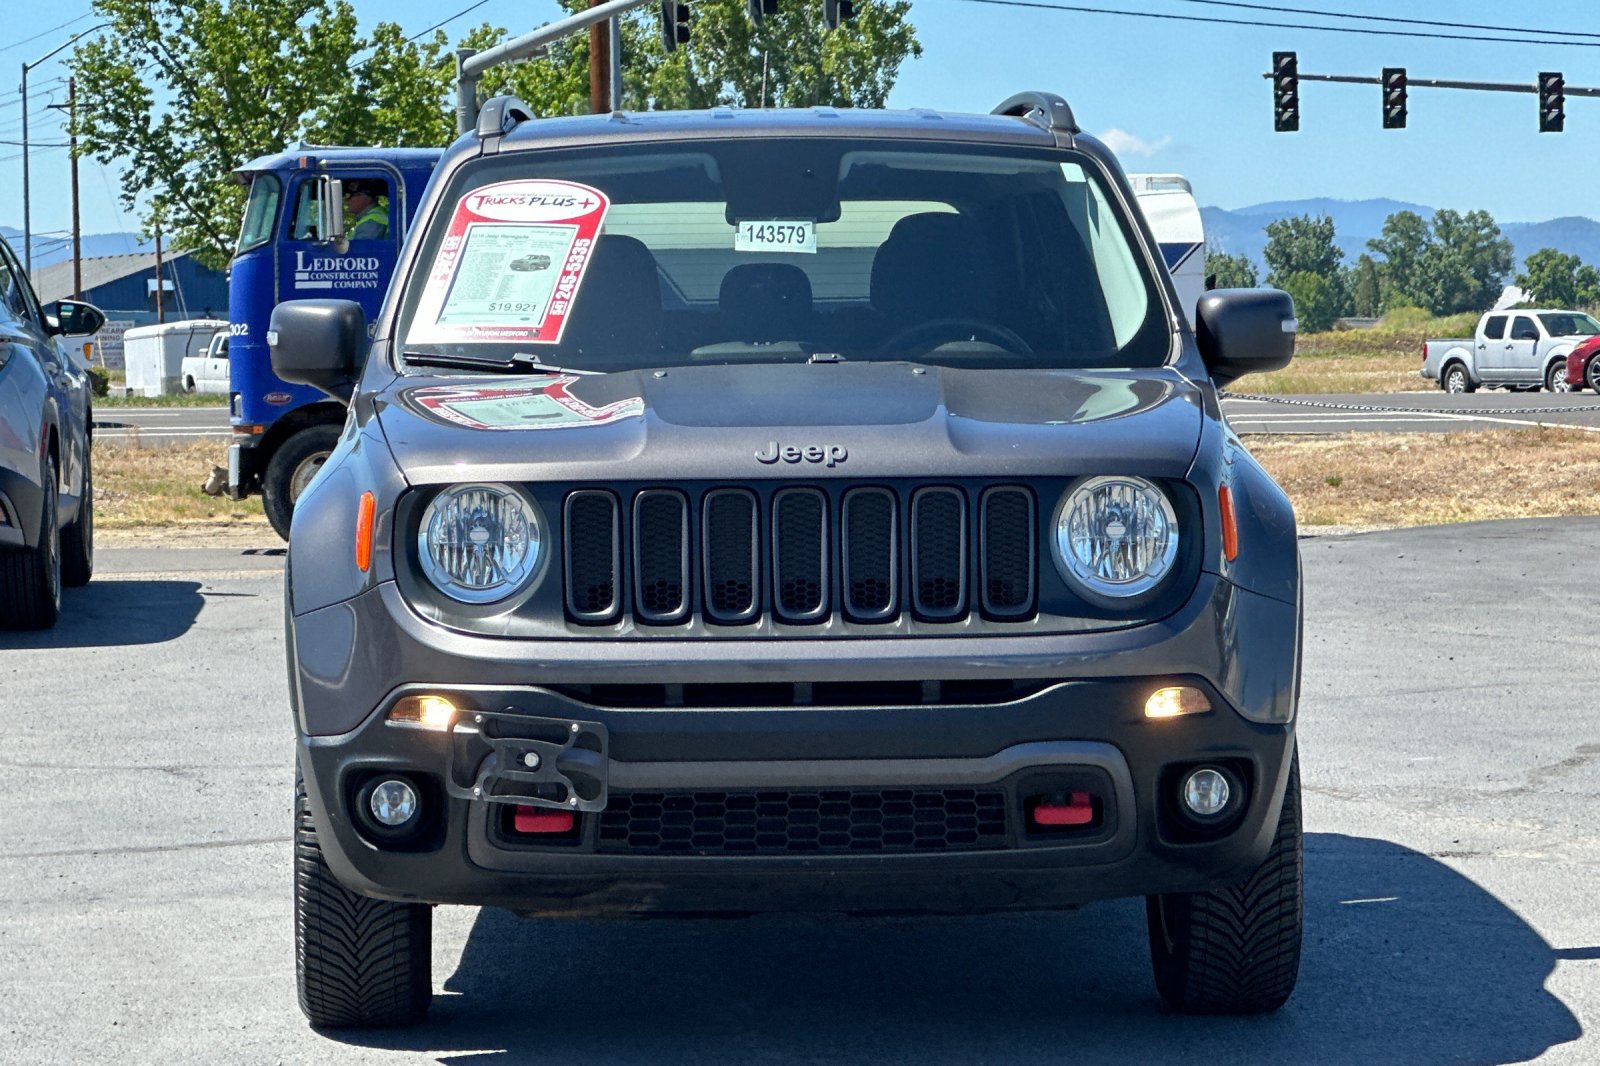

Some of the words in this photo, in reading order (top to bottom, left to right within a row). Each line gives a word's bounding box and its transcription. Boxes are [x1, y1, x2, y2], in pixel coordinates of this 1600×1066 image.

[474, 195, 526, 210] TRUCKS
[528, 197, 576, 206] PLUS
[747, 225, 806, 244] 143579
[295, 251, 380, 271] LEDFORD
[555, 238, 591, 300] 245-5335
[310, 272, 379, 281] CONSTRUCTION
[333, 281, 378, 289] COMPANY
[488, 302, 537, 313] $19,921
[754, 440, 848, 468] Jeep
